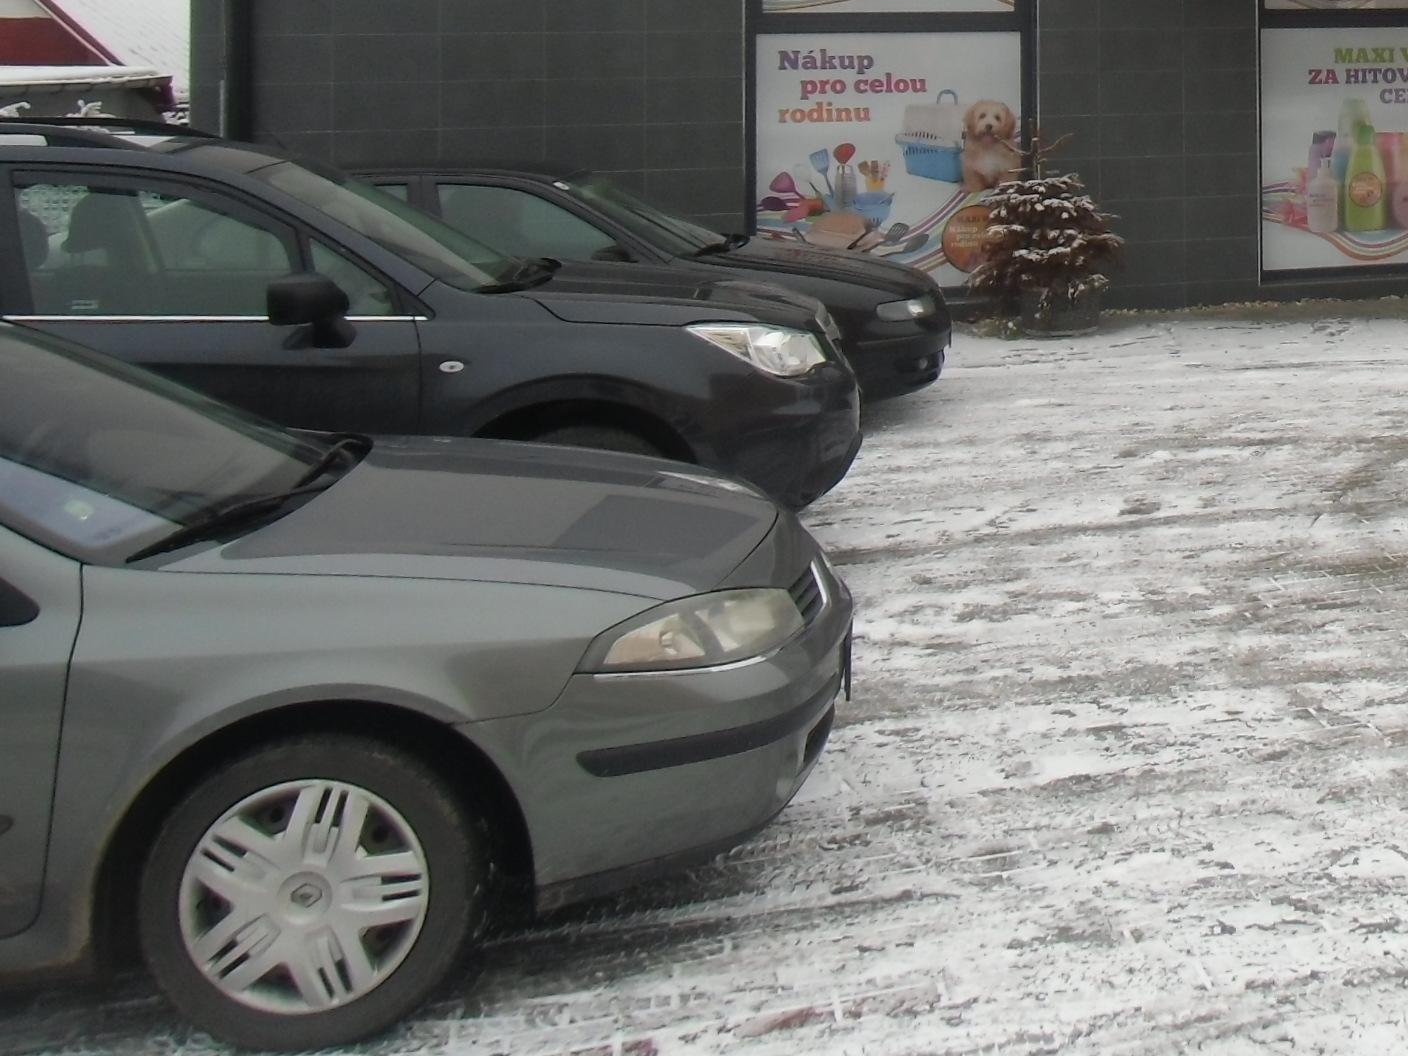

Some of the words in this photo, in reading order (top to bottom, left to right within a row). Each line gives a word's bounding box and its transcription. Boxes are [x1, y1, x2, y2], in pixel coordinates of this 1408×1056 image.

[778, 49, 874, 75] Nákup
[1334, 47, 1395, 64] MAXI
[800, 76, 847, 101] pro
[854, 73, 928, 94] celou
[1308, 69, 1339, 85] ZA
[778, 102, 871, 124] rodinu
